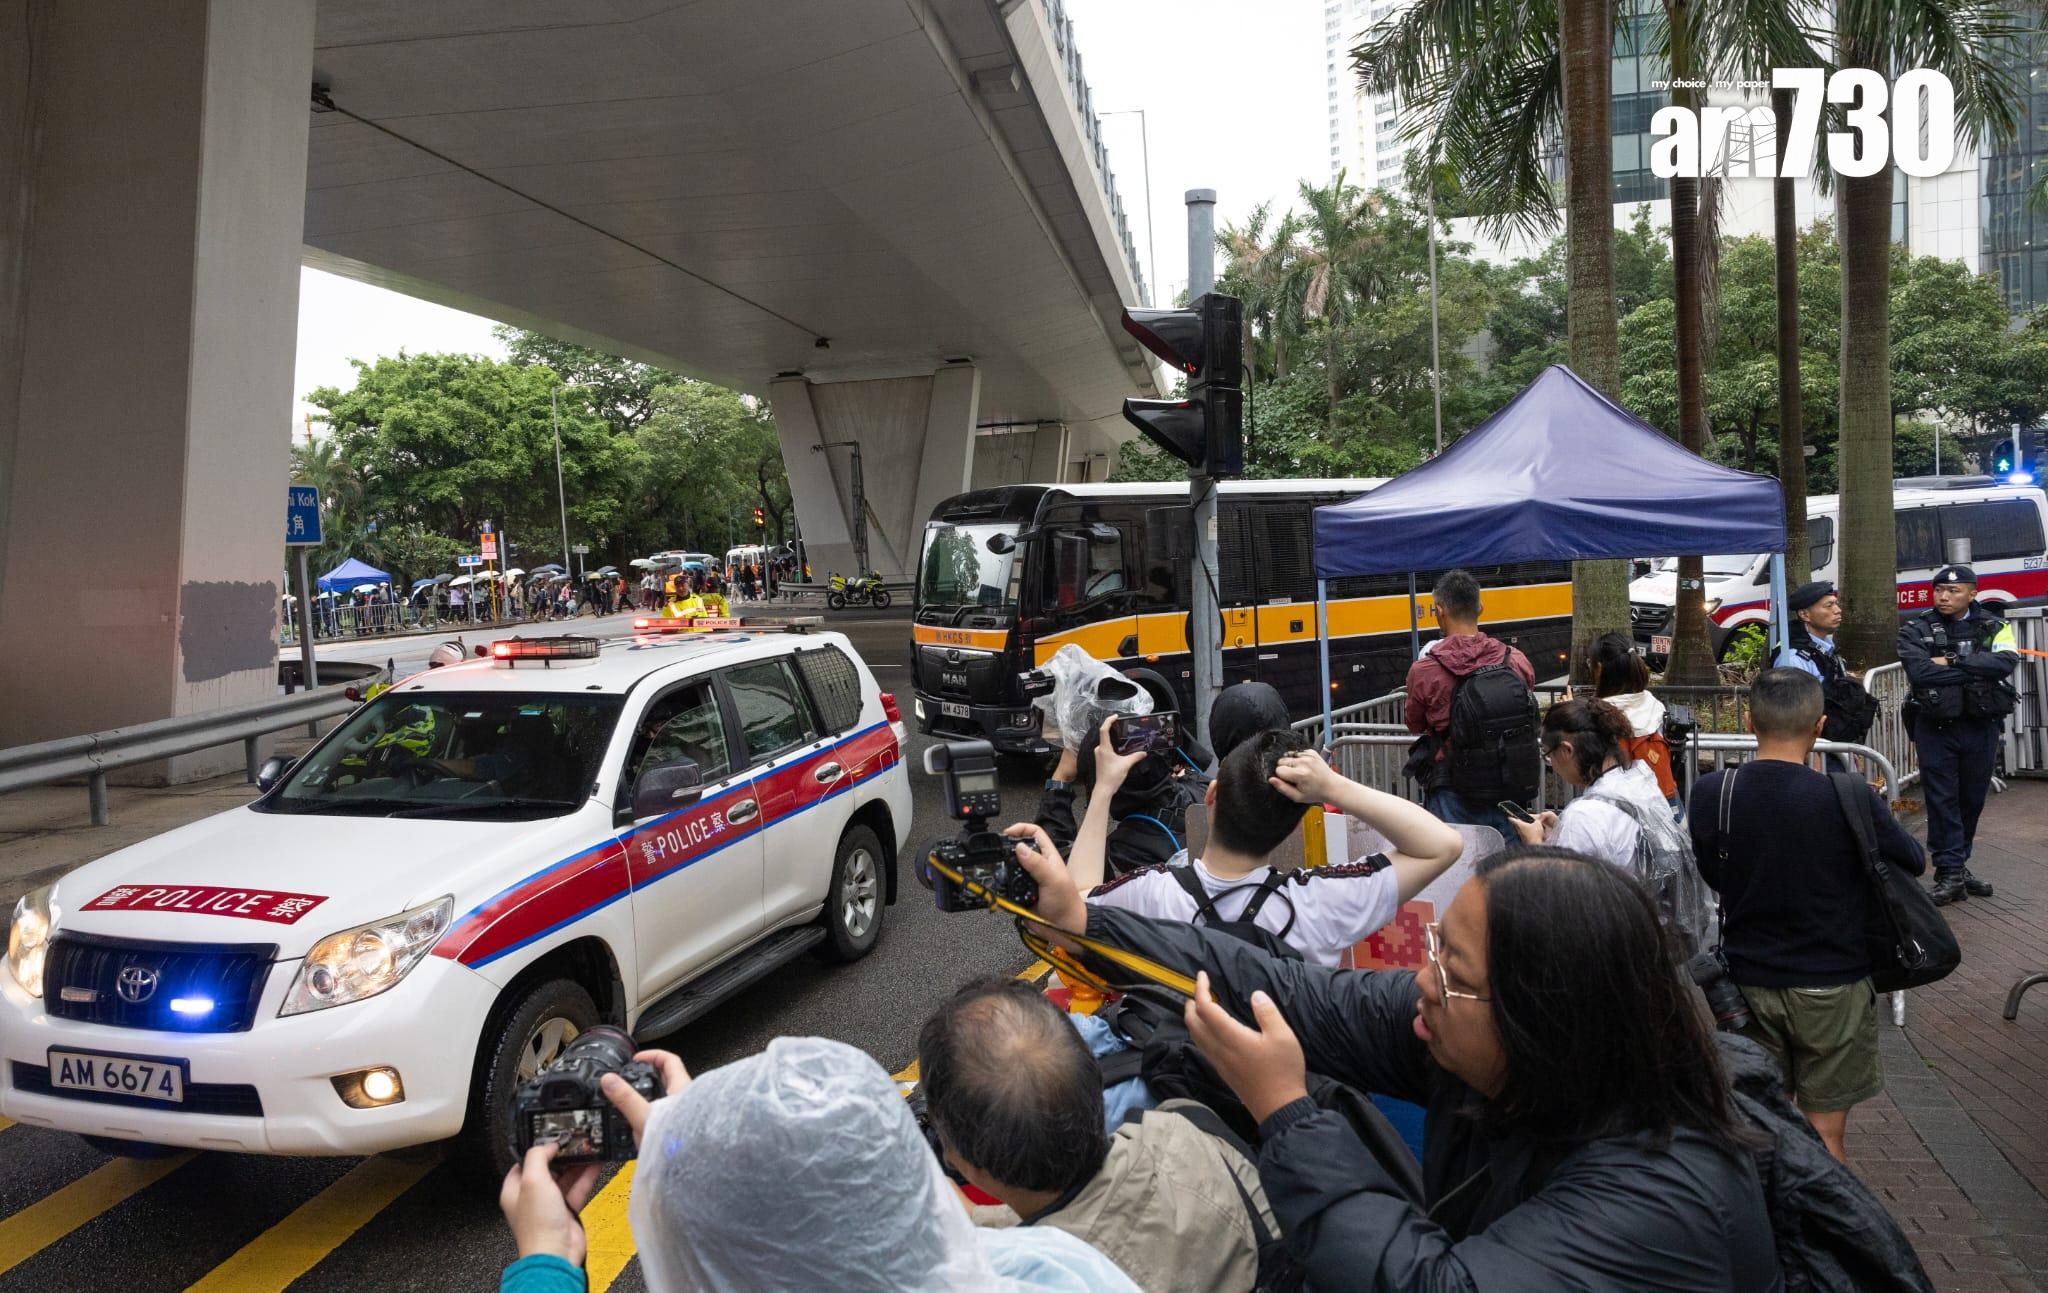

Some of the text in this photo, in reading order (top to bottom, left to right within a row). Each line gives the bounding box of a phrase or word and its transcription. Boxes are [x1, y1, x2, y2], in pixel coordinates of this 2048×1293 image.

[297, 492, 316, 507] Kok
[288, 514, 305, 536] 角
[942, 672, 967, 687] MAN
[942, 703, 969, 717] AM 4378
[641, 811, 726, 865] 警 POLICE 察
[96, 887, 314, 918] 警 POLICE 察
[59, 1057, 174, 1098] AM 6674
